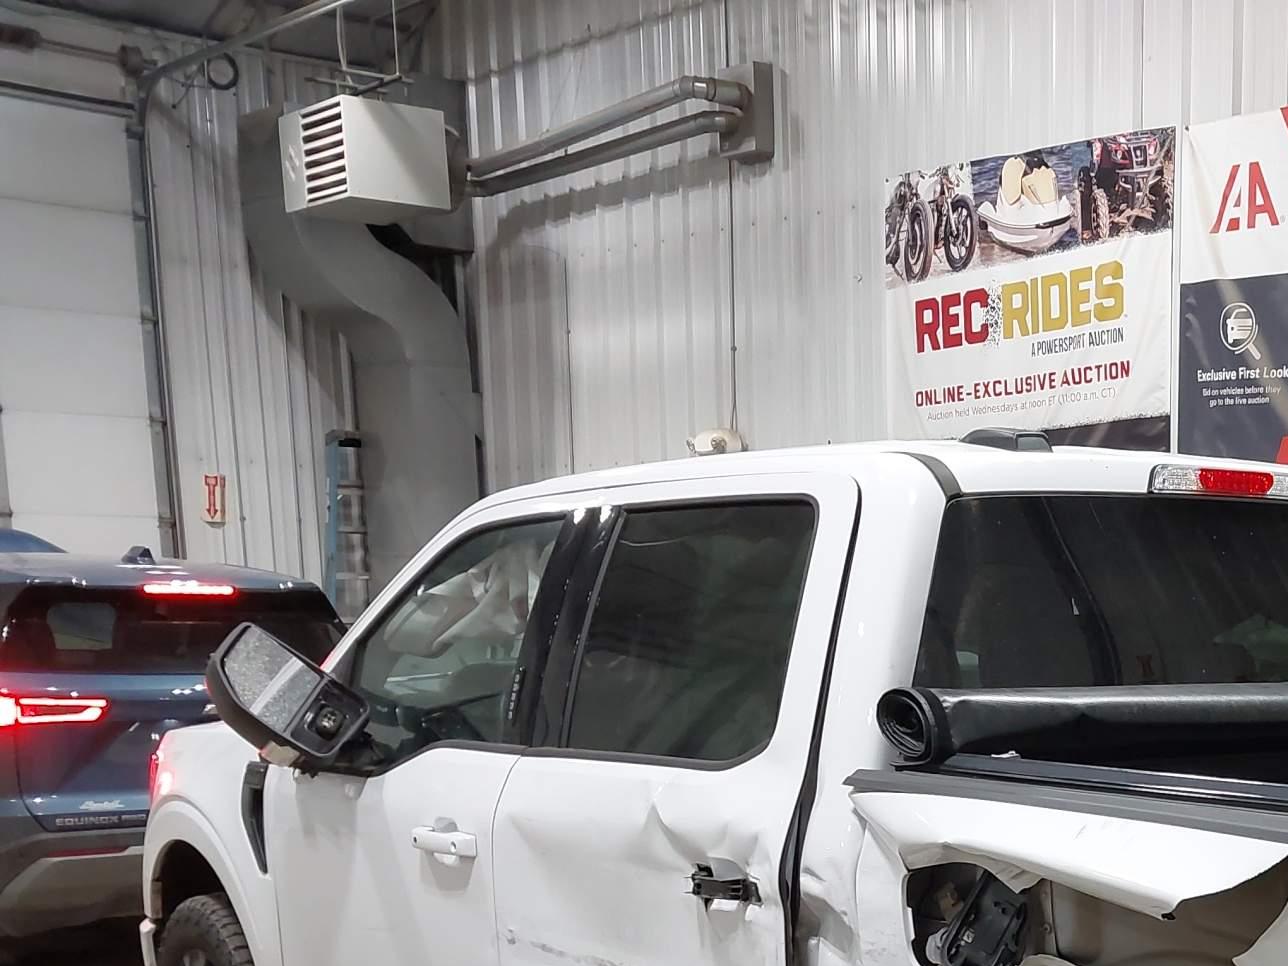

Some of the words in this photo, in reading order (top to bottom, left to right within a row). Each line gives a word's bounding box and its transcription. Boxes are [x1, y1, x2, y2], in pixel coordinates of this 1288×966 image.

[915, 288, 989, 353] REC
[1001, 260, 1124, 339] RIDES
[1031, 343, 1036, 357] A
[1088, 327, 1124, 348] AUCTION
[916, 372, 1057, 407] ONLINE-EXCLUSIVE
[1061, 360, 1131, 385] AUCTION
[1197, 369, 1236, 382] Exclusive
[1238, 367, 1260, 380] First
[1263, 366, 1288, 378] Look
[1209, 399, 1216, 407] go
[1218, 398, 1223, 406] to
[1224, 397, 1234, 405] the
[1247, 395, 1269, 405] auction
[1220, 387, 1244, 396] vehicles
[1245, 386, 1263, 395] before
[1265, 385, 1281, 395] they
[927, 408, 953, 422] Auction
[955, 406, 970, 417] held
[972, 402, 1018, 416] Wednesdays
[1020, 401, 1028, 410] at
[1049, 396, 1056, 406] ET
[1101, 389, 1116, 401] CT)
[55, 815, 119, 826] EQUINOX
